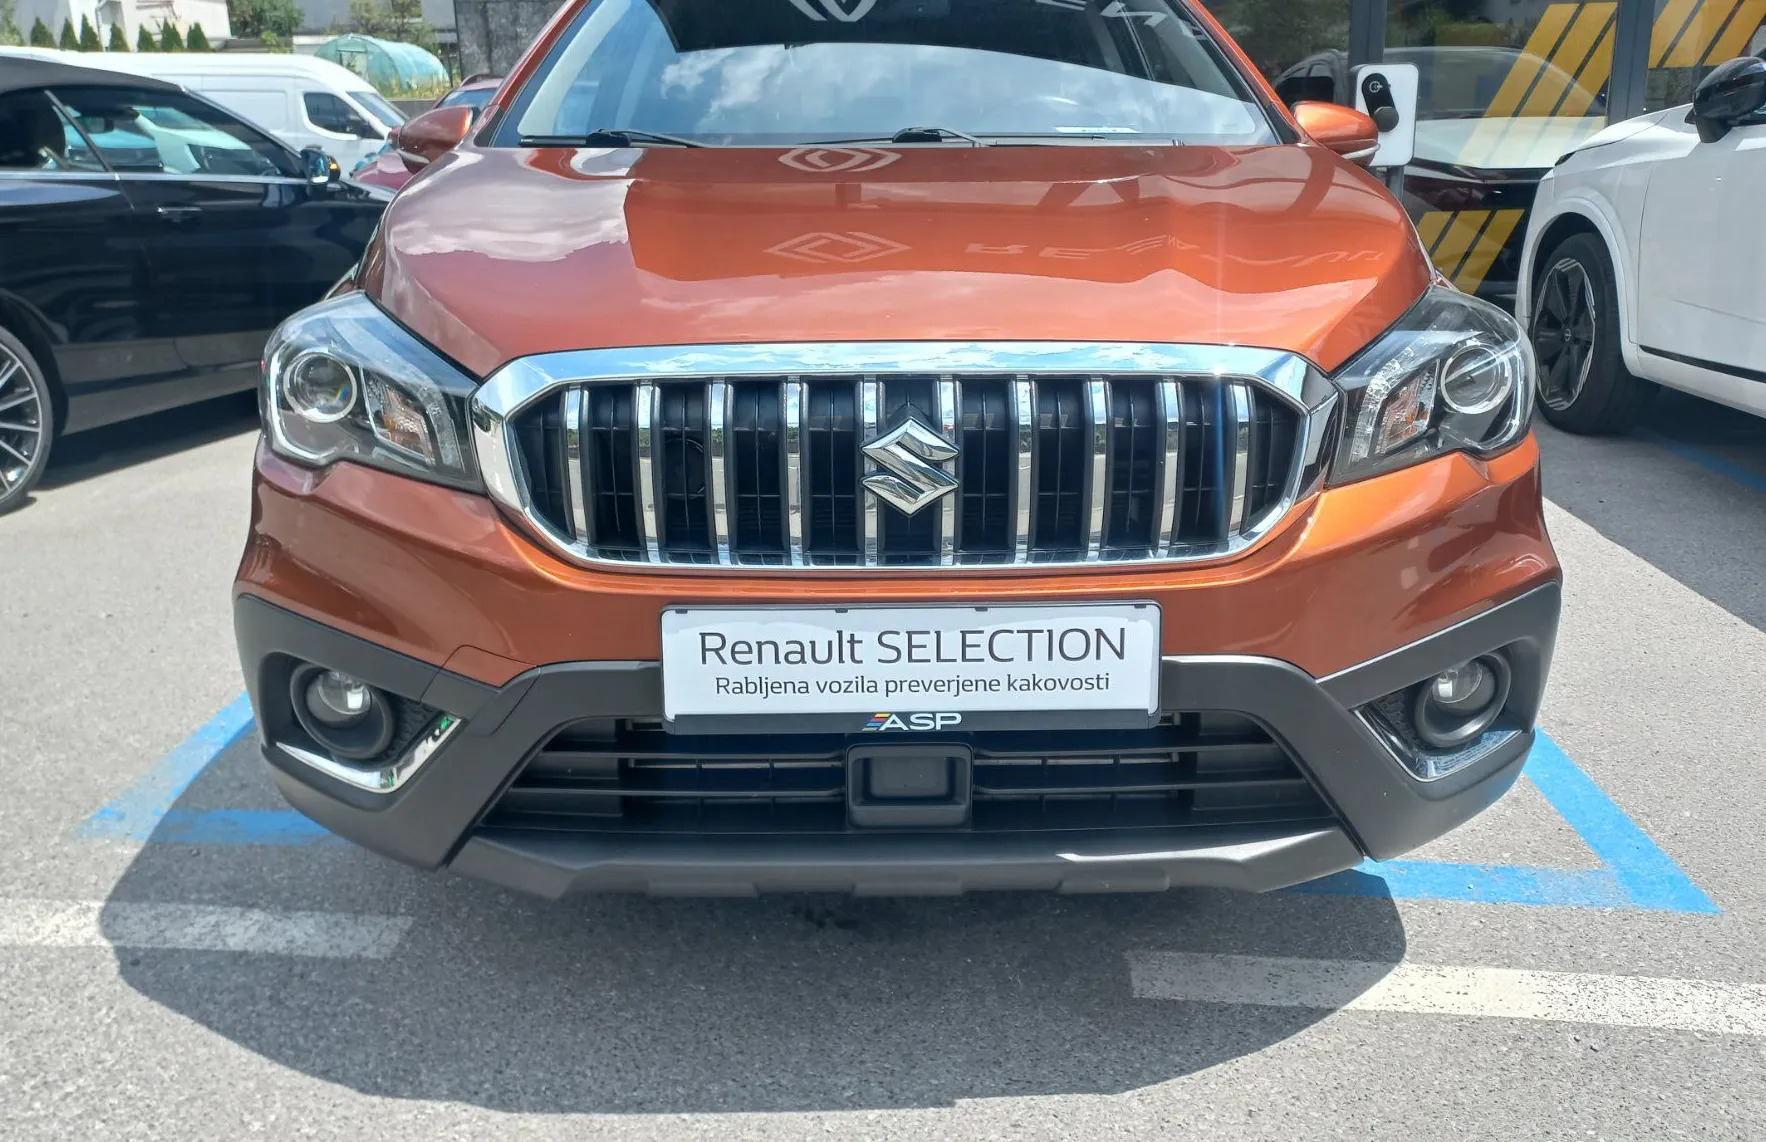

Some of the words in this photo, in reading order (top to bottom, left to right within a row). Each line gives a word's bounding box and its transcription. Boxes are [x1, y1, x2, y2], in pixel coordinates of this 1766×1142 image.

[699, 630, 864, 666] Renault
[877, 627, 1127, 664] SELECTION
[715, 676, 810, 700] Rabljena
[815, 675, 879, 694] vozila
[884, 675, 1001, 698] preverjene
[1006, 673, 1110, 692] kakovosti
[878, 712, 962, 731] ASP
